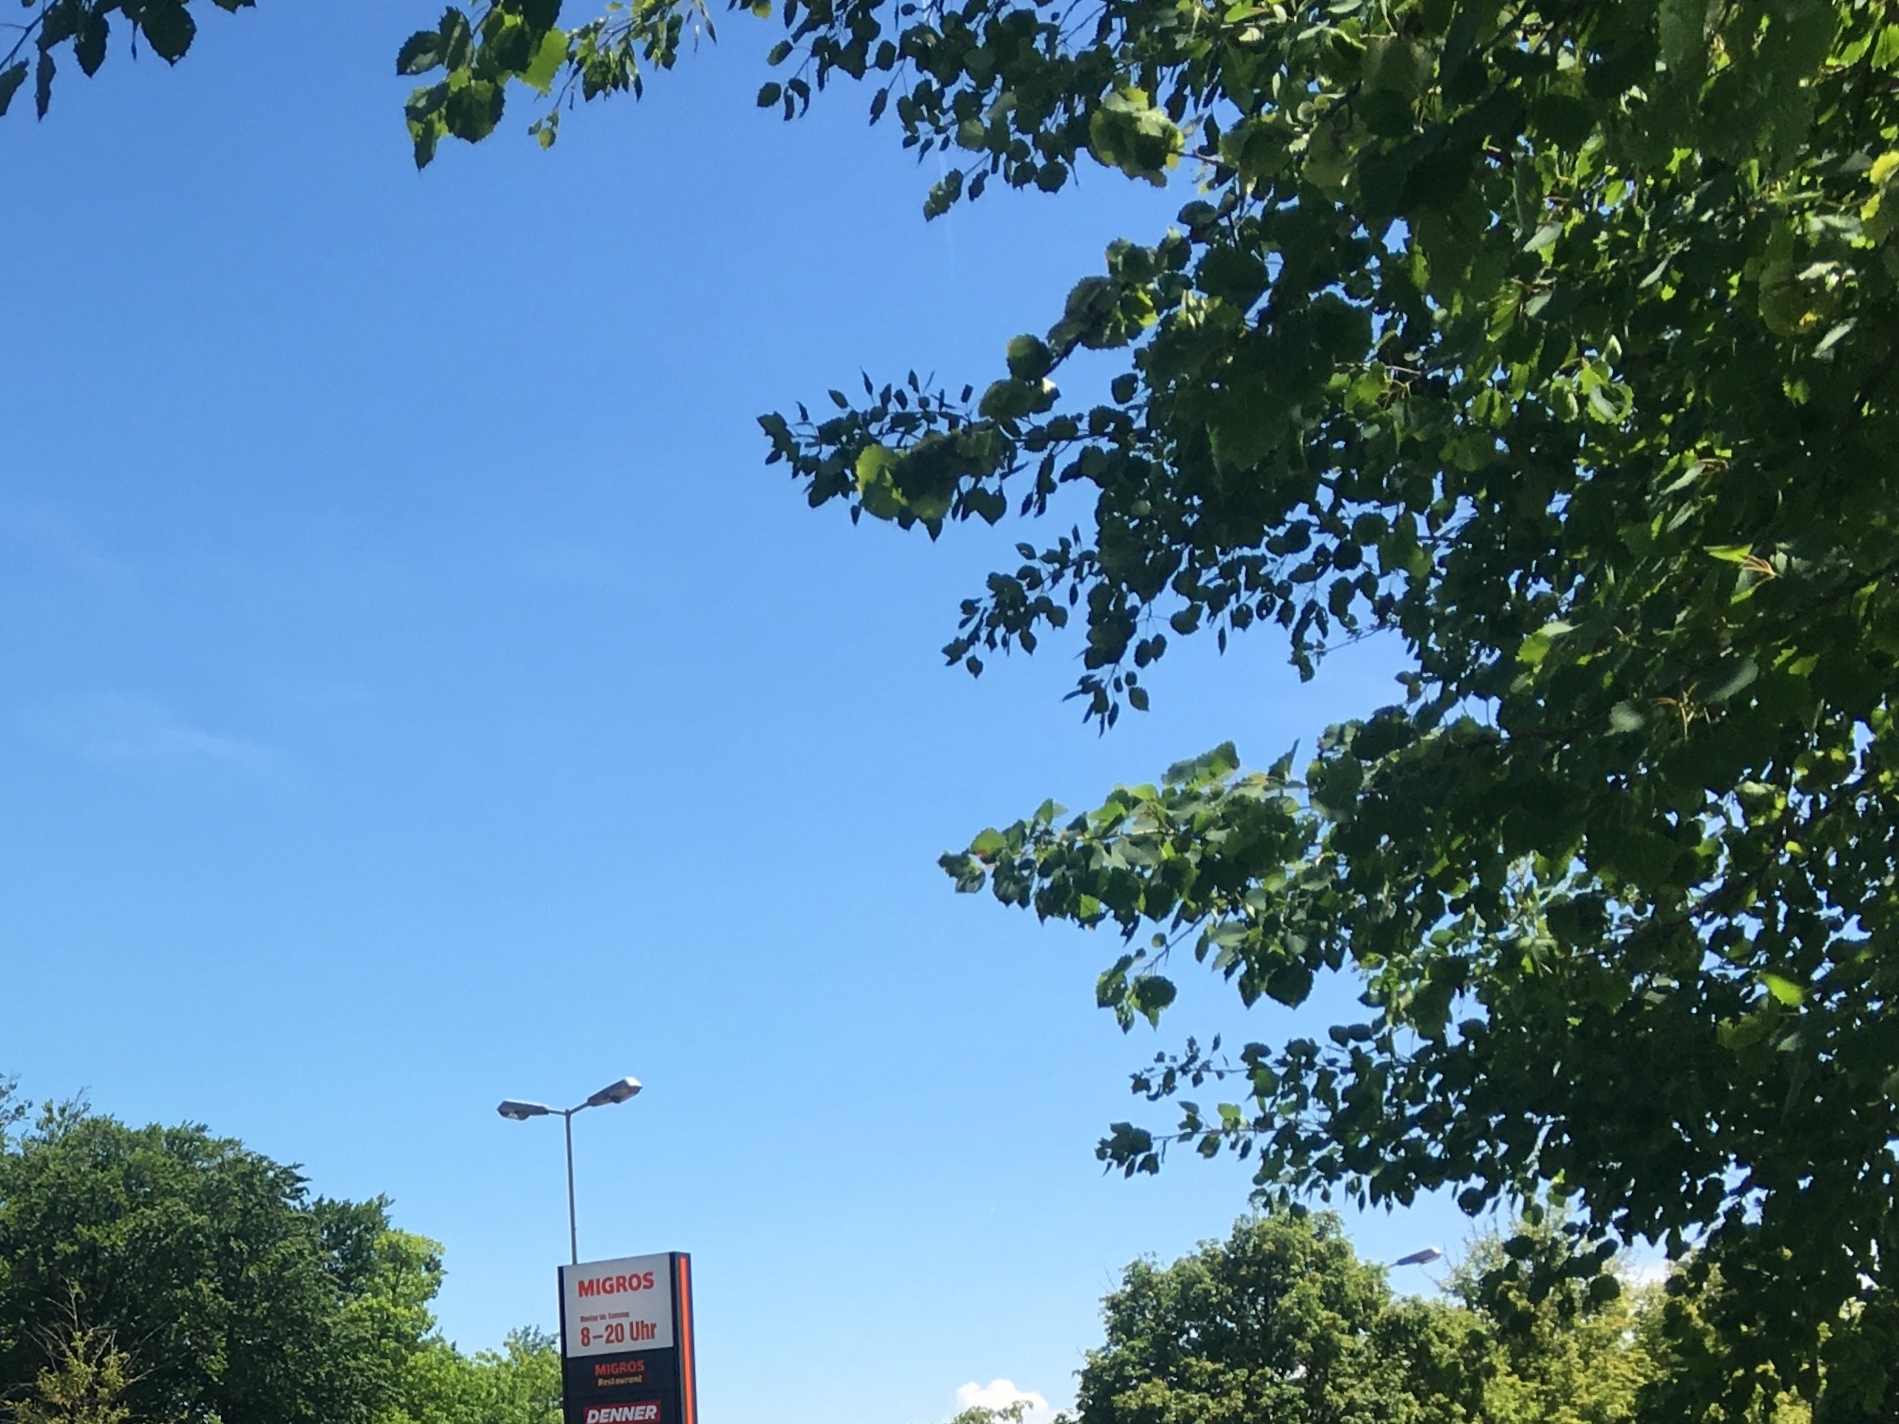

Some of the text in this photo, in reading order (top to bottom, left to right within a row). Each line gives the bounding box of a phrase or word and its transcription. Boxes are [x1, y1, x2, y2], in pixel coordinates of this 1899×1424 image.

[578, 1271, 655, 1297] MIGROS
[629, 1319, 657, 1341] Uhr
[594, 1360, 645, 1376] MIGROS
[586, 1405, 657, 1424] DENNER
